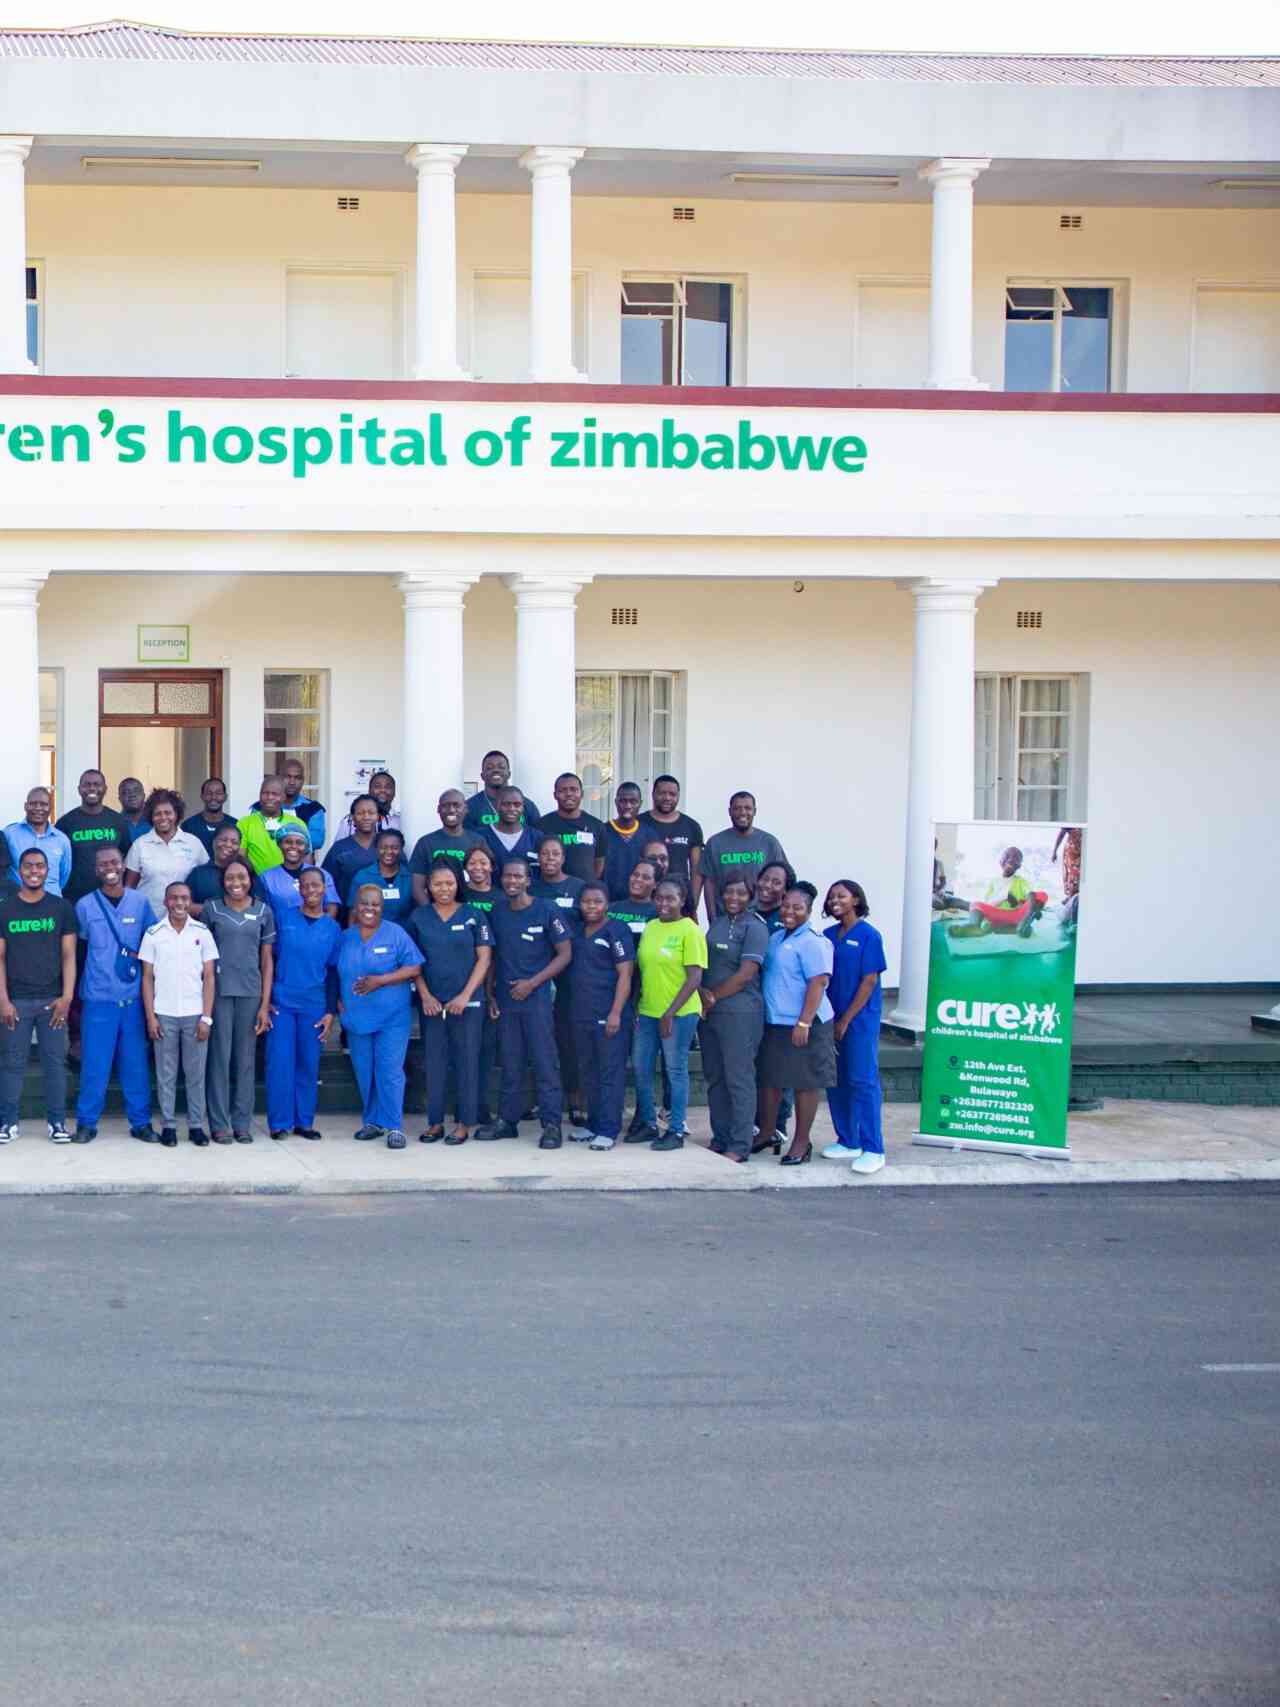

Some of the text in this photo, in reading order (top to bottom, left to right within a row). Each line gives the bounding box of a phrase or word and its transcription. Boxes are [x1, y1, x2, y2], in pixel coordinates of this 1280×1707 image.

[167, 409, 448, 479] hospital
[464, 415, 532, 467] of
[550, 417, 868, 473] zimbabwe
[144, 639, 186, 648] RECEPTION
[72, 829, 102, 842] cure
[720, 852, 750, 864] cure
[8, 920, 40, 933] cure
[937, 999, 1021, 1030] cure
[970, 1086, 1018, 1099] Bulawayo
